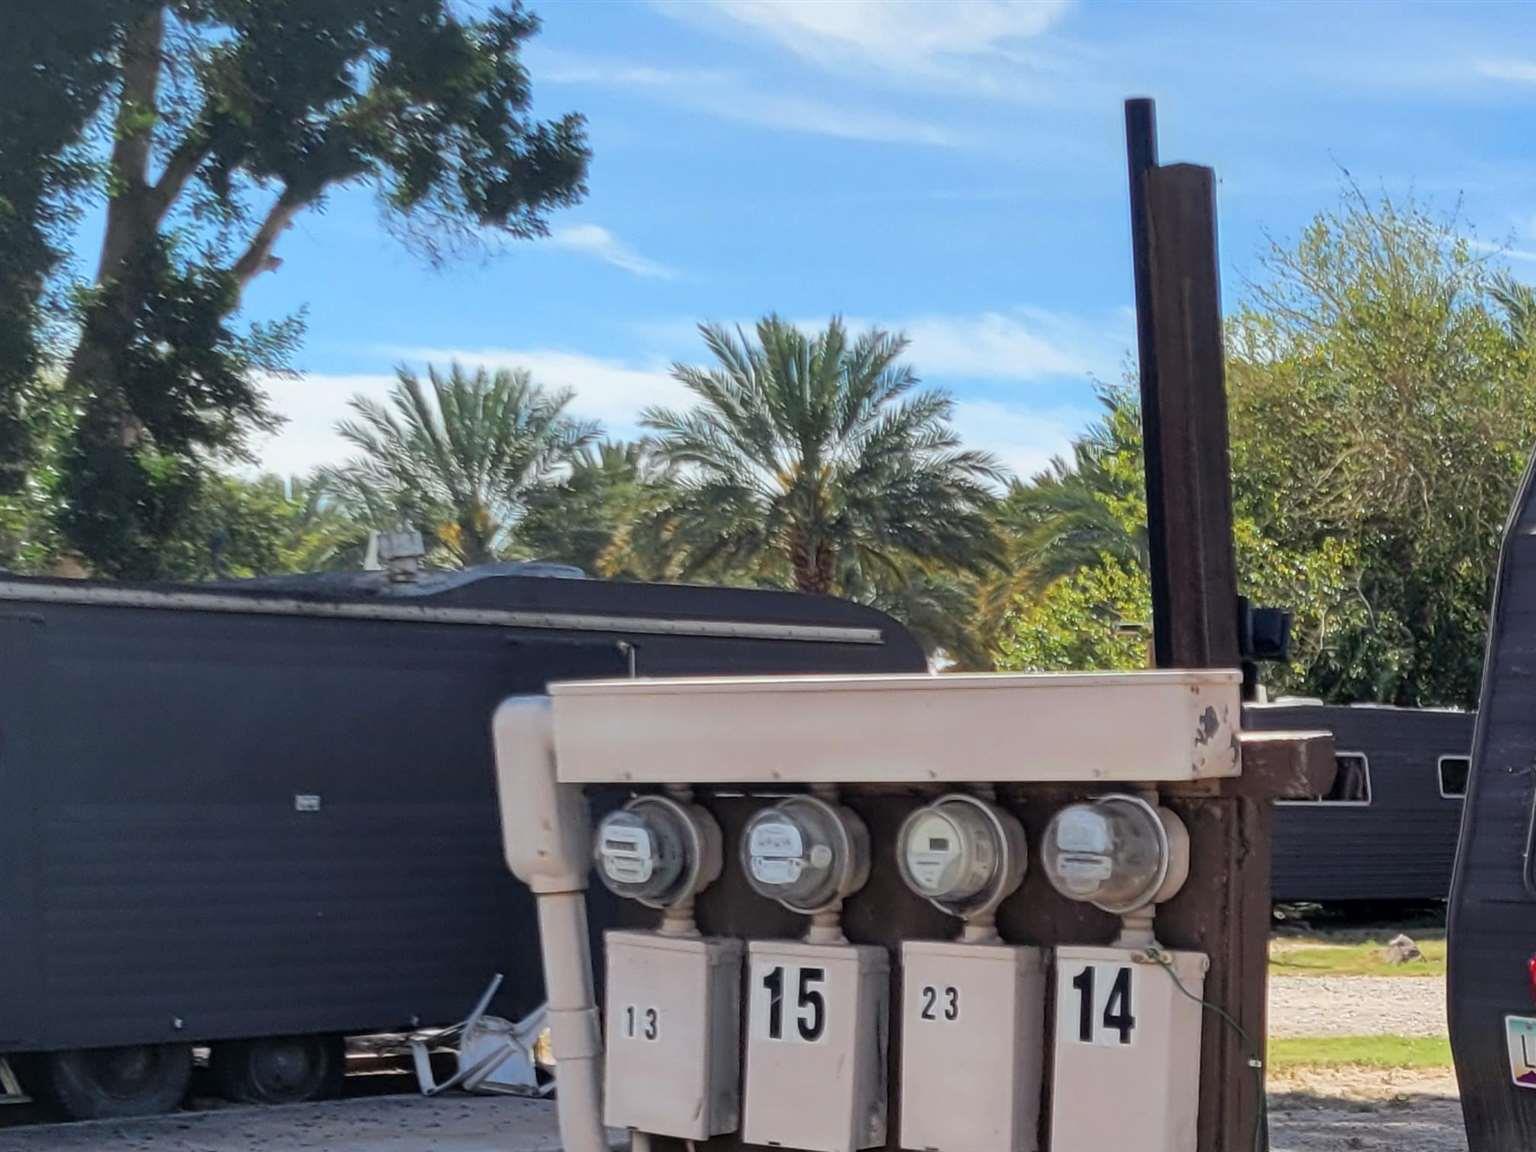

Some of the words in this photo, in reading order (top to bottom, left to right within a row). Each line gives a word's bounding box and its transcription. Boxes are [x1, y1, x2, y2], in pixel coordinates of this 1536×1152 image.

[627, 1006, 657, 1040] 13
[763, 966, 825, 1042] 15
[921, 986, 958, 1021] 23
[1073, 966, 1135, 1044] 14
